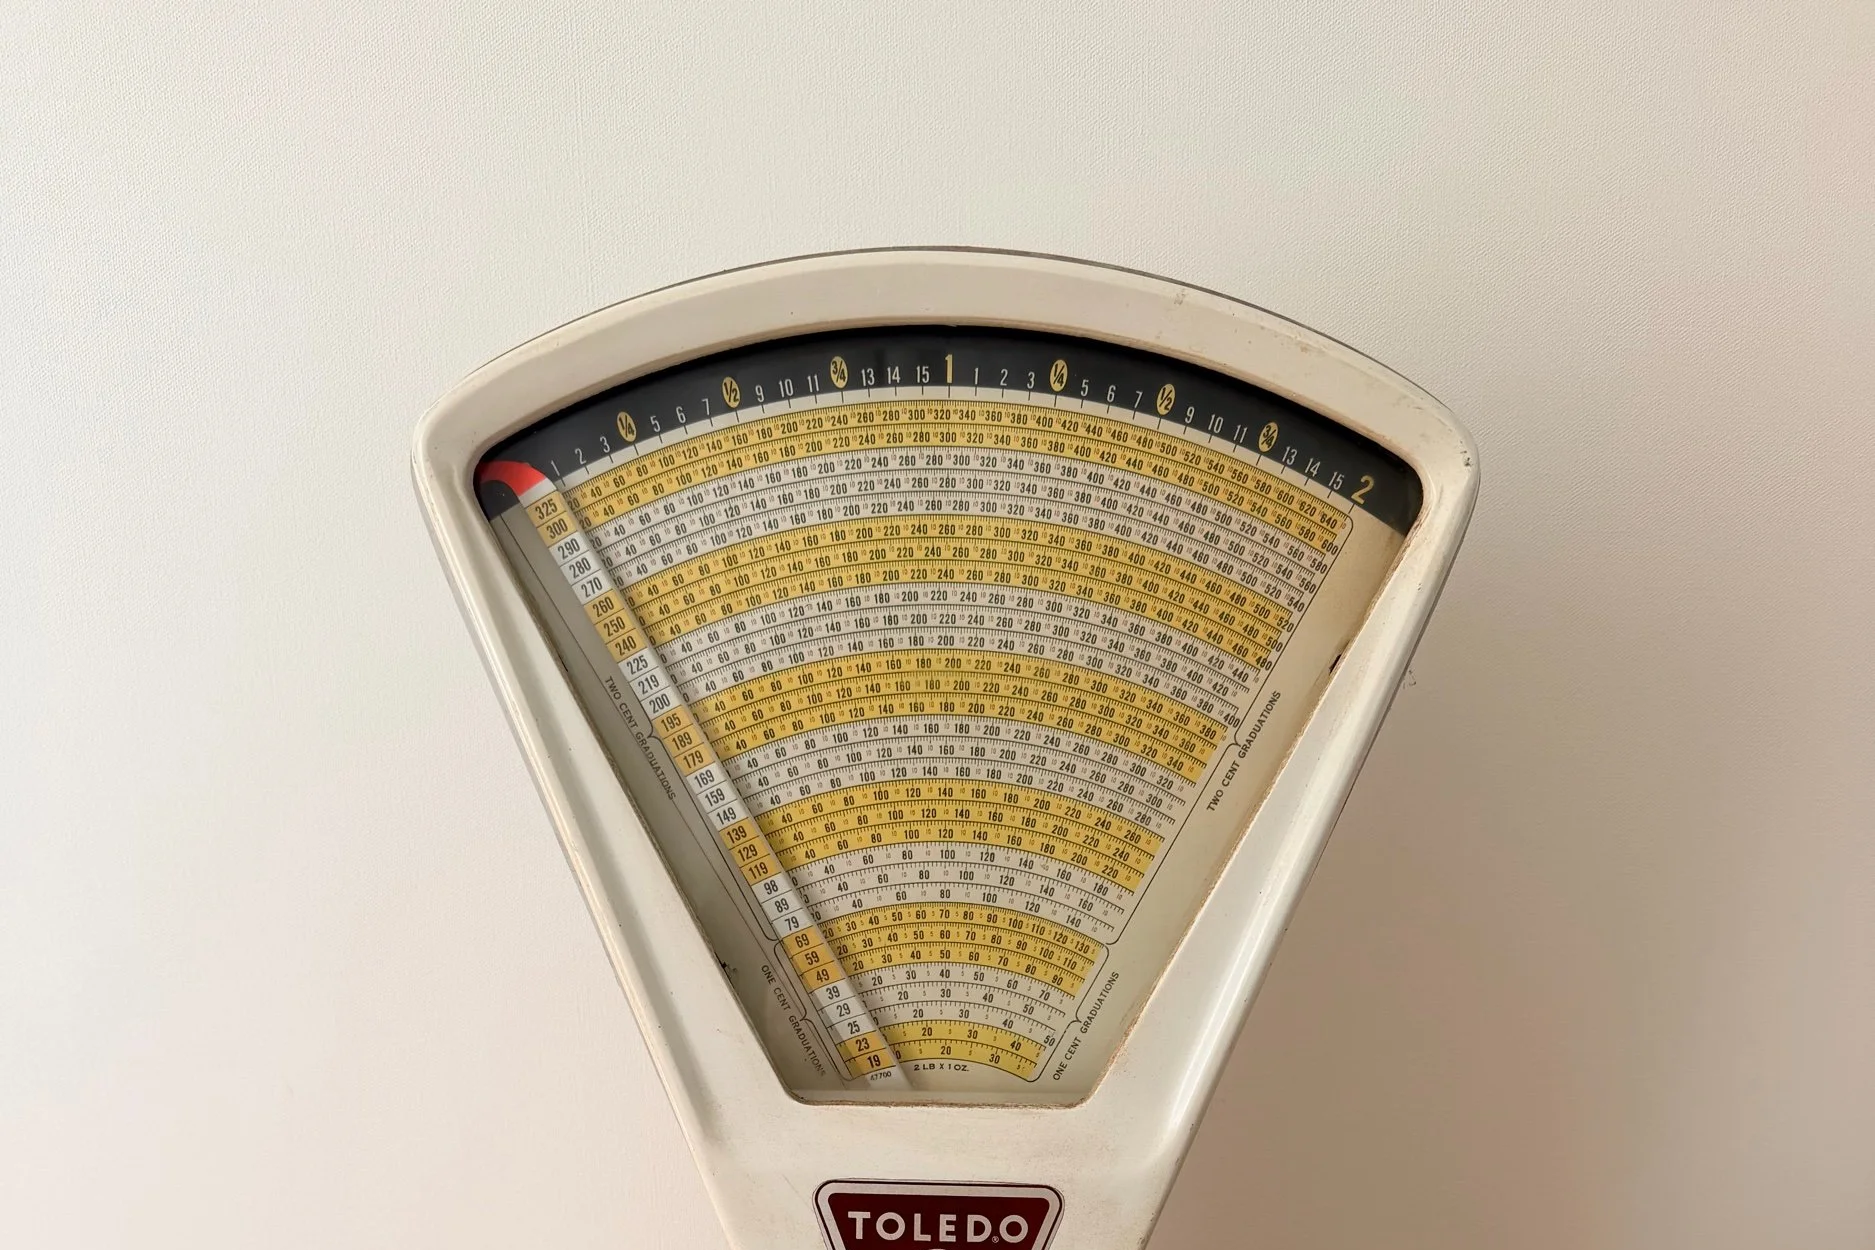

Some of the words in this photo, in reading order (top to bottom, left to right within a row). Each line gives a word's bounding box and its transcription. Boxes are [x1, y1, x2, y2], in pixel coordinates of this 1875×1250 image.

[551, 461, 560, 477] 1
[575, 448, 586, 465] 2
[600, 436, 611, 453] 3
[650, 416, 661, 433] 5
[676, 407, 686, 423] 6
[702, 399, 711, 415] 7
[755, 386, 765, 401] 9
[778, 379, 794, 396] 10
[807, 376, 820, 392] 11
[860, 369, 875, 386] 13
[886, 367, 900, 384] 14
[916, 367, 930, 383] 15
[945, 354, 954, 384] 1
[1000, 369, 1007, 386] 2
[1027, 372, 1035, 389] 3
[1081, 380, 1089, 396] 5
[1106, 385, 1116, 402] 6
[1134, 391, 1143, 408] 7
[1185, 407, 1194, 423] 9
[1208, 414, 1224, 433] 10
[1234, 425, 1249, 442] 11
[1282, 446, 1297, 465] 13
[1305, 458, 1321, 477] 14
[1328, 471, 1345, 491] 15
[1352, 475, 1375, 504] 2
[658, 452, 676, 469] 100
[731, 431, 748, 447] 160
[780, 419, 799, 435] 200
[857, 410, 875, 425] 260
[908, 408, 926, 422] 300
[984, 409, 1003, 424] 360
[1035, 415, 1054, 430] 400
[1111, 428, 1129, 444] 460
[1159, 440, 1178, 457] 500
[1230, 468, 1249, 486] 560
[1276, 489, 1295, 507] 600
[535, 498, 558, 520] 325
[546, 518, 568, 539] 300
[558, 538, 581, 558] 290
[569, 558, 592, 578] 280
[581, 577, 603, 597] 270
[593, 597, 614, 617] 260
[604, 617, 625, 636] 250
[615, 636, 636, 656] 240
[627, 655, 648, 675] 225
[638, 675, 659, 694] 219
[649, 694, 671, 714] 200
[661, 713, 681, 732] 195
[605, 675, 622, 700] TWO
[619, 702, 639, 729] CENT
[635, 731, 677, 800] GRADUATIONS
[672, 732, 693, 751] 189
[683, 750, 703, 769] 179
[1206, 789, 1224, 812] TWO
[1221, 760, 1240, 787] CENT
[1237, 690, 1281, 759] GRADUATIONS
[695, 770, 714, 789] 169
[706, 789, 726, 808] 159
[717, 807, 737, 825] 149
[726, 826, 747, 843] 139
[738, 845, 758, 863] 129
[749, 863, 768, 880] 119
[764, 880, 778, 894] 98
[775, 899, 789, 912] 89
[785, 916, 799, 930] 79
[795, 935, 810, 948] 69
[805, 951, 820, 965] 59
[816, 969, 829, 982] 49
[761, 964, 777, 986] ONE
[773, 987, 791, 1011] CENT
[826, 986, 840, 999] 39
[837, 1003, 851, 1016] 29
[898, 990, 909, 1000] 20
[940, 988, 951, 998] 30
[982, 992, 993, 1002] 40
[1023, 1004, 1034, 1015] 50
[848, 1021, 860, 1033] 25
[913, 1009, 924, 1018] 20
[959, 1009, 969, 1018] 30
[1002, 1018, 1014, 1029] 40
[1044, 1034, 1055, 1046] 50
[1052, 1061, 1068, 1081] ONE
[1064, 1036, 1082, 1060] CENT
[1080, 971, 1119, 1034] GRADUATIONS
[856, 1038, 870, 1051] 23
[921, 1027, 932, 1036] 20
[967, 1029, 978, 1039] 30
[1010, 1040, 1022, 1051] 40
[867, 1056, 881, 1068] 19
[941, 1046, 951, 1055] 20
[989, 1053, 1000, 1064] 30
[847, 1211, 1029, 1244] TOLEDO
